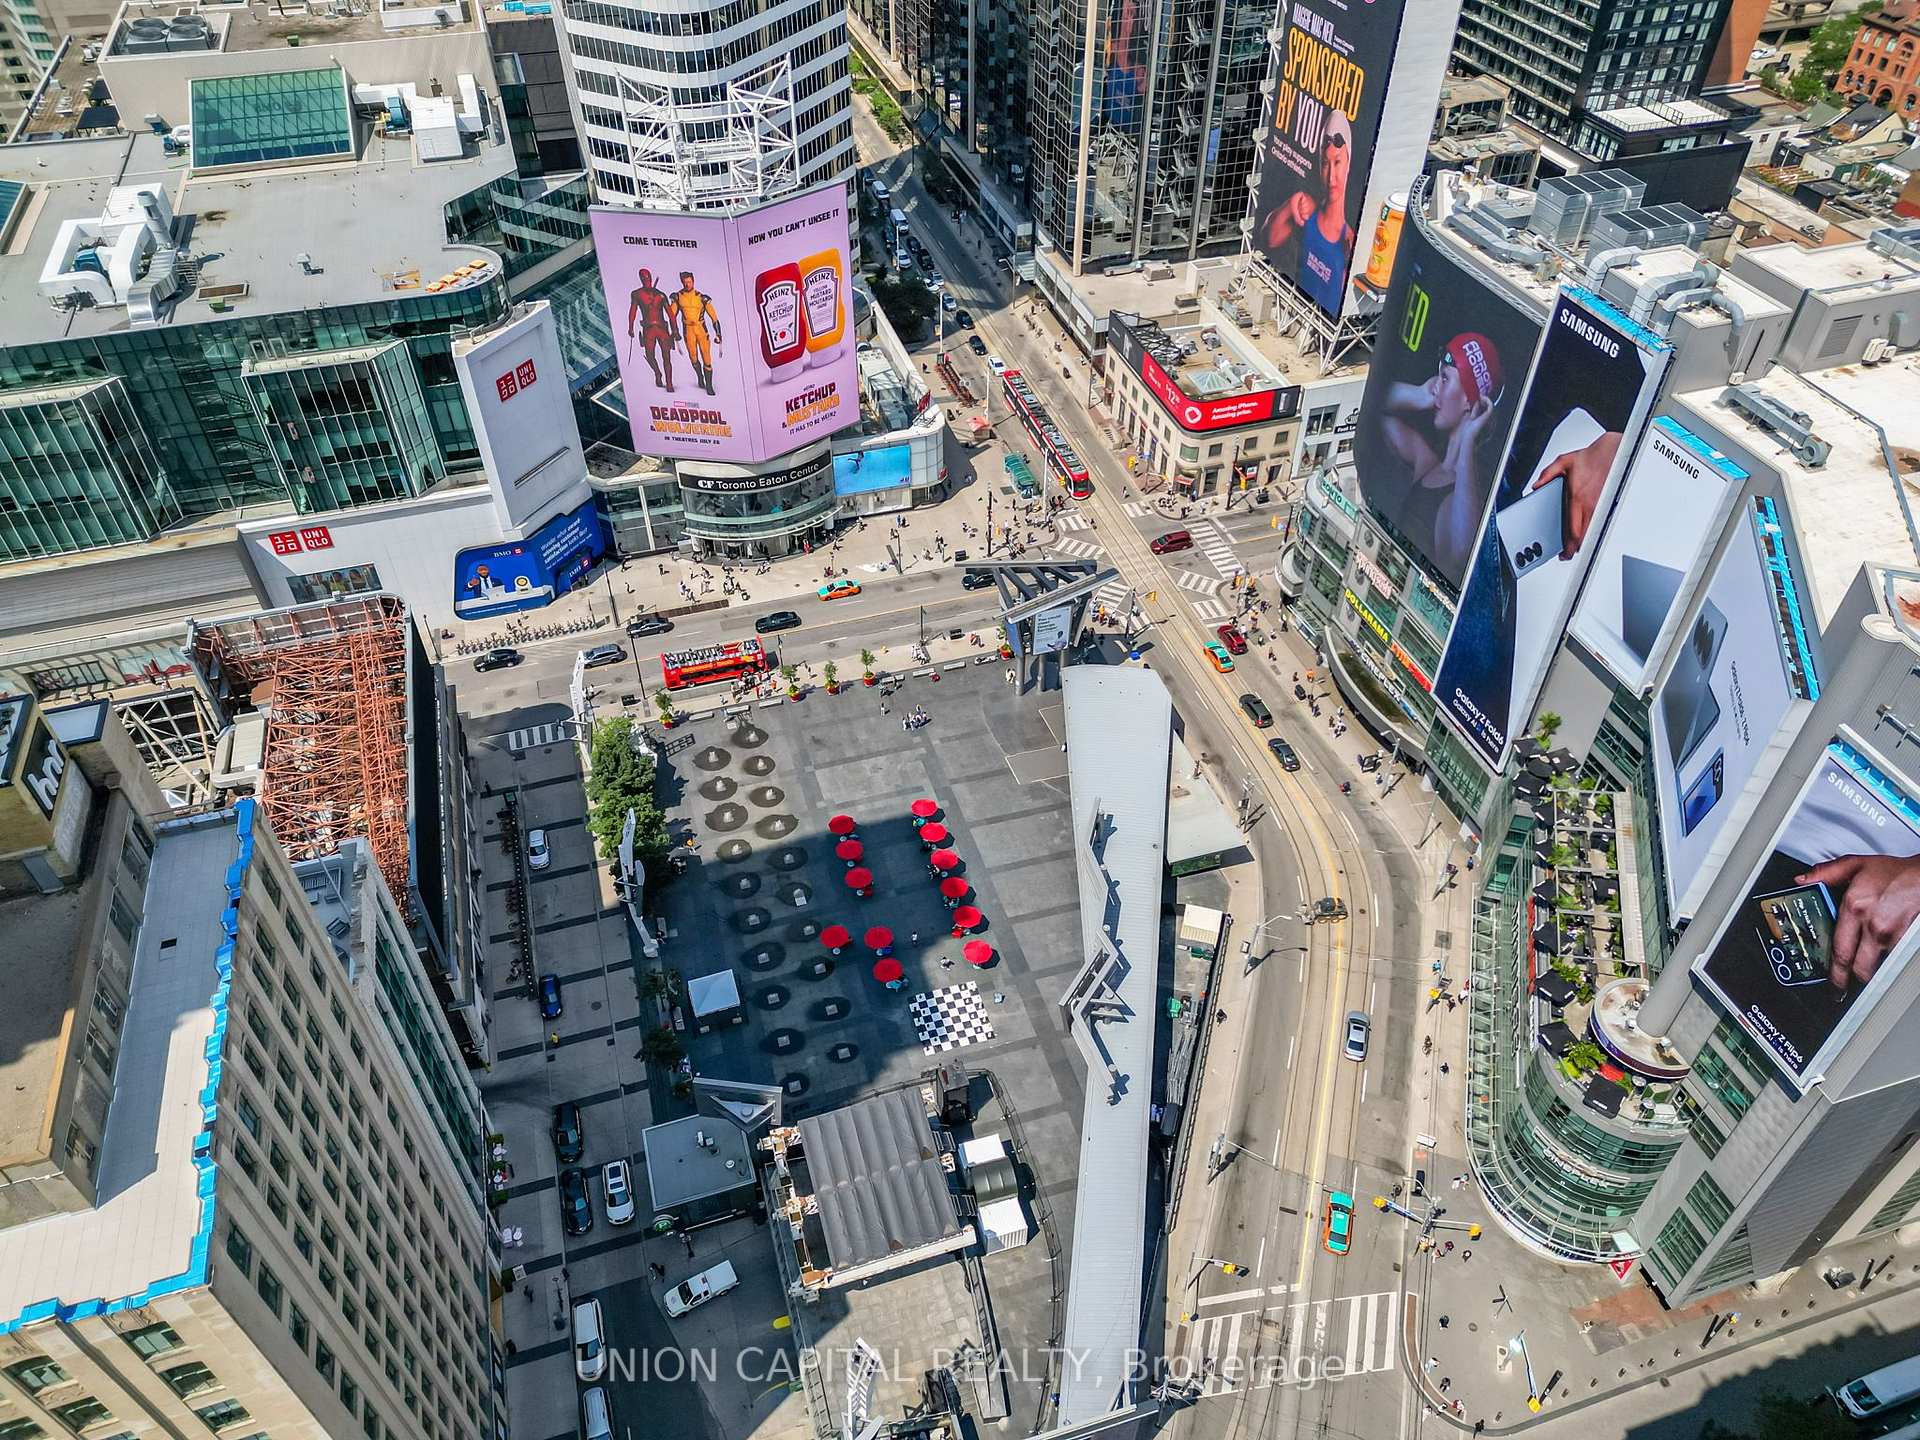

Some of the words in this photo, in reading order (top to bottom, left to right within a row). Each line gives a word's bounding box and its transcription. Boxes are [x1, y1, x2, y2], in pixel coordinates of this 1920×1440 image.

[1284, 26, 1364, 122] SPONSORED
[1275, 79, 1298, 134] BY
[1294, 90, 1324, 154] YOU
[623, 235, 649, 246] COME
[651, 237, 698, 249] TOGETHER
[748, 234, 766, 246] NOW
[768, 227, 784, 241] YOU
[785, 219, 806, 234] CAN'T
[808, 212, 831, 227] UNSEE
[832, 208, 840, 219] IT
[768, 288, 790, 301] HEINZ
[809, 272, 831, 286] HEINZ
[769, 304, 794, 319] KETCHUP
[1559, 308, 1620, 359] SAMSUNG
[649, 406, 727, 425] DEADPOOL
[785, 382, 836, 414] KETCHUP
[786, 393, 840, 427] MUSTARD
[1210, 412, 1237, 421] Amazing
[1211, 405, 1238, 414] Amazing
[653, 420, 733, 438] WOLVERINE
[795, 423, 806, 433] HAS
[698, 479, 714, 489] CF
[716, 479, 757, 490] Toronto
[759, 473, 788, 487] Eaton
[789, 462, 820, 481] Centre
[1652, 438, 1700, 480] SAMSUNG
[1345, 589, 1389, 642] DOLLARAMA
[1361, 653, 1401, 703] CINEPLEX
[1452, 699, 1471, 722] Galaxy
[1485, 735, 1499, 753] here
[1455, 687, 1481, 719] Galaxy
[1479, 713, 1486, 724] Z
[1484, 719, 1504, 745] Fold6
[1826, 770, 1888, 829] SAMSUNG
[1746, 1011, 1767, 1034] Galaxy
[1783, 1051, 1798, 1069] here
[1751, 1004, 1780, 1037] Galaxy
[1778, 1034, 1786, 1043] Z
[1783, 1040, 1803, 1063] Flip6
[1543, 1147, 1608, 1188] CINEPLEX
